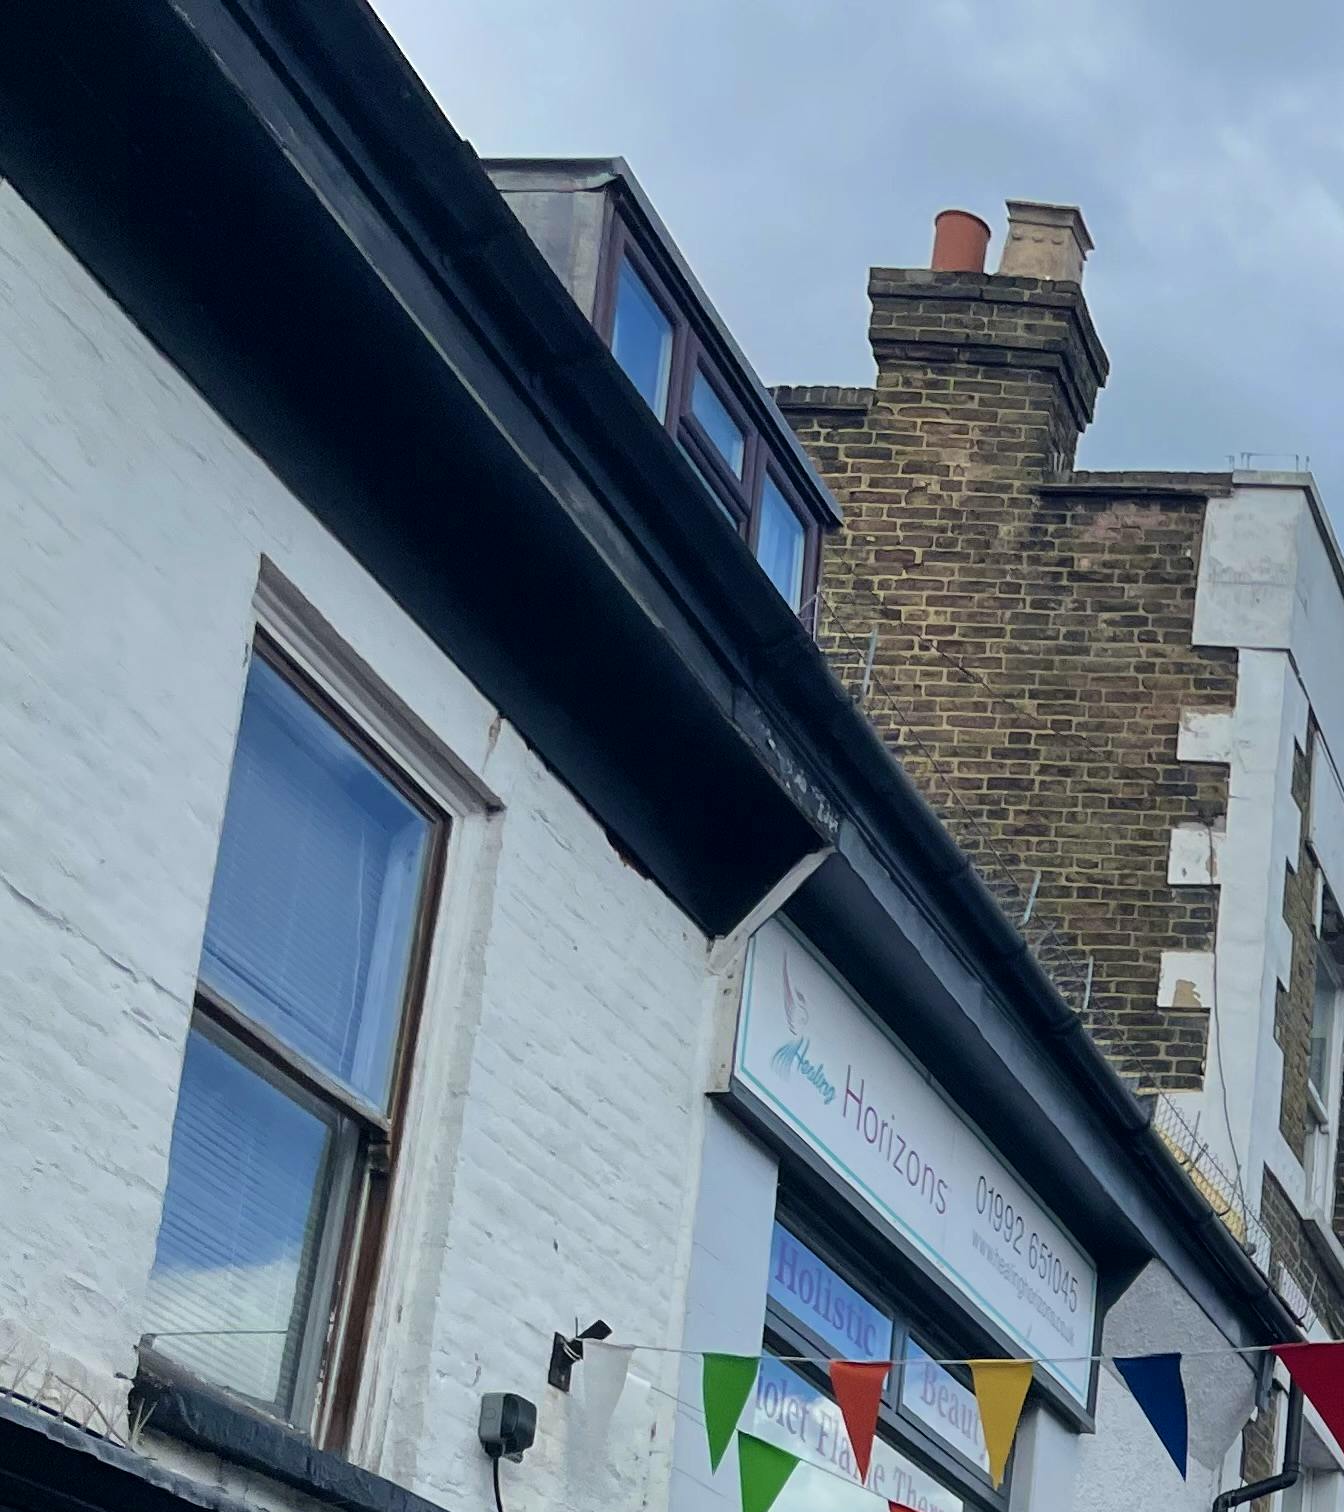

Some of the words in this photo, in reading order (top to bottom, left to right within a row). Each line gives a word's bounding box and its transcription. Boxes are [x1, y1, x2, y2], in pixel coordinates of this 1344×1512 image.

[791, 1035, 836, 1105] Healing
[843, 1064, 948, 1215] Horizons
[774, 1238, 877, 1357] Holistic
[975, 1175, 1024, 1255] 01992
[1029, 1232, 1079, 1313] 651045
[755, 1372, 810, 1444] iolet
[815, 1408, 886, 1498] Flae
[919, 1362, 987, 1461] Beaut
